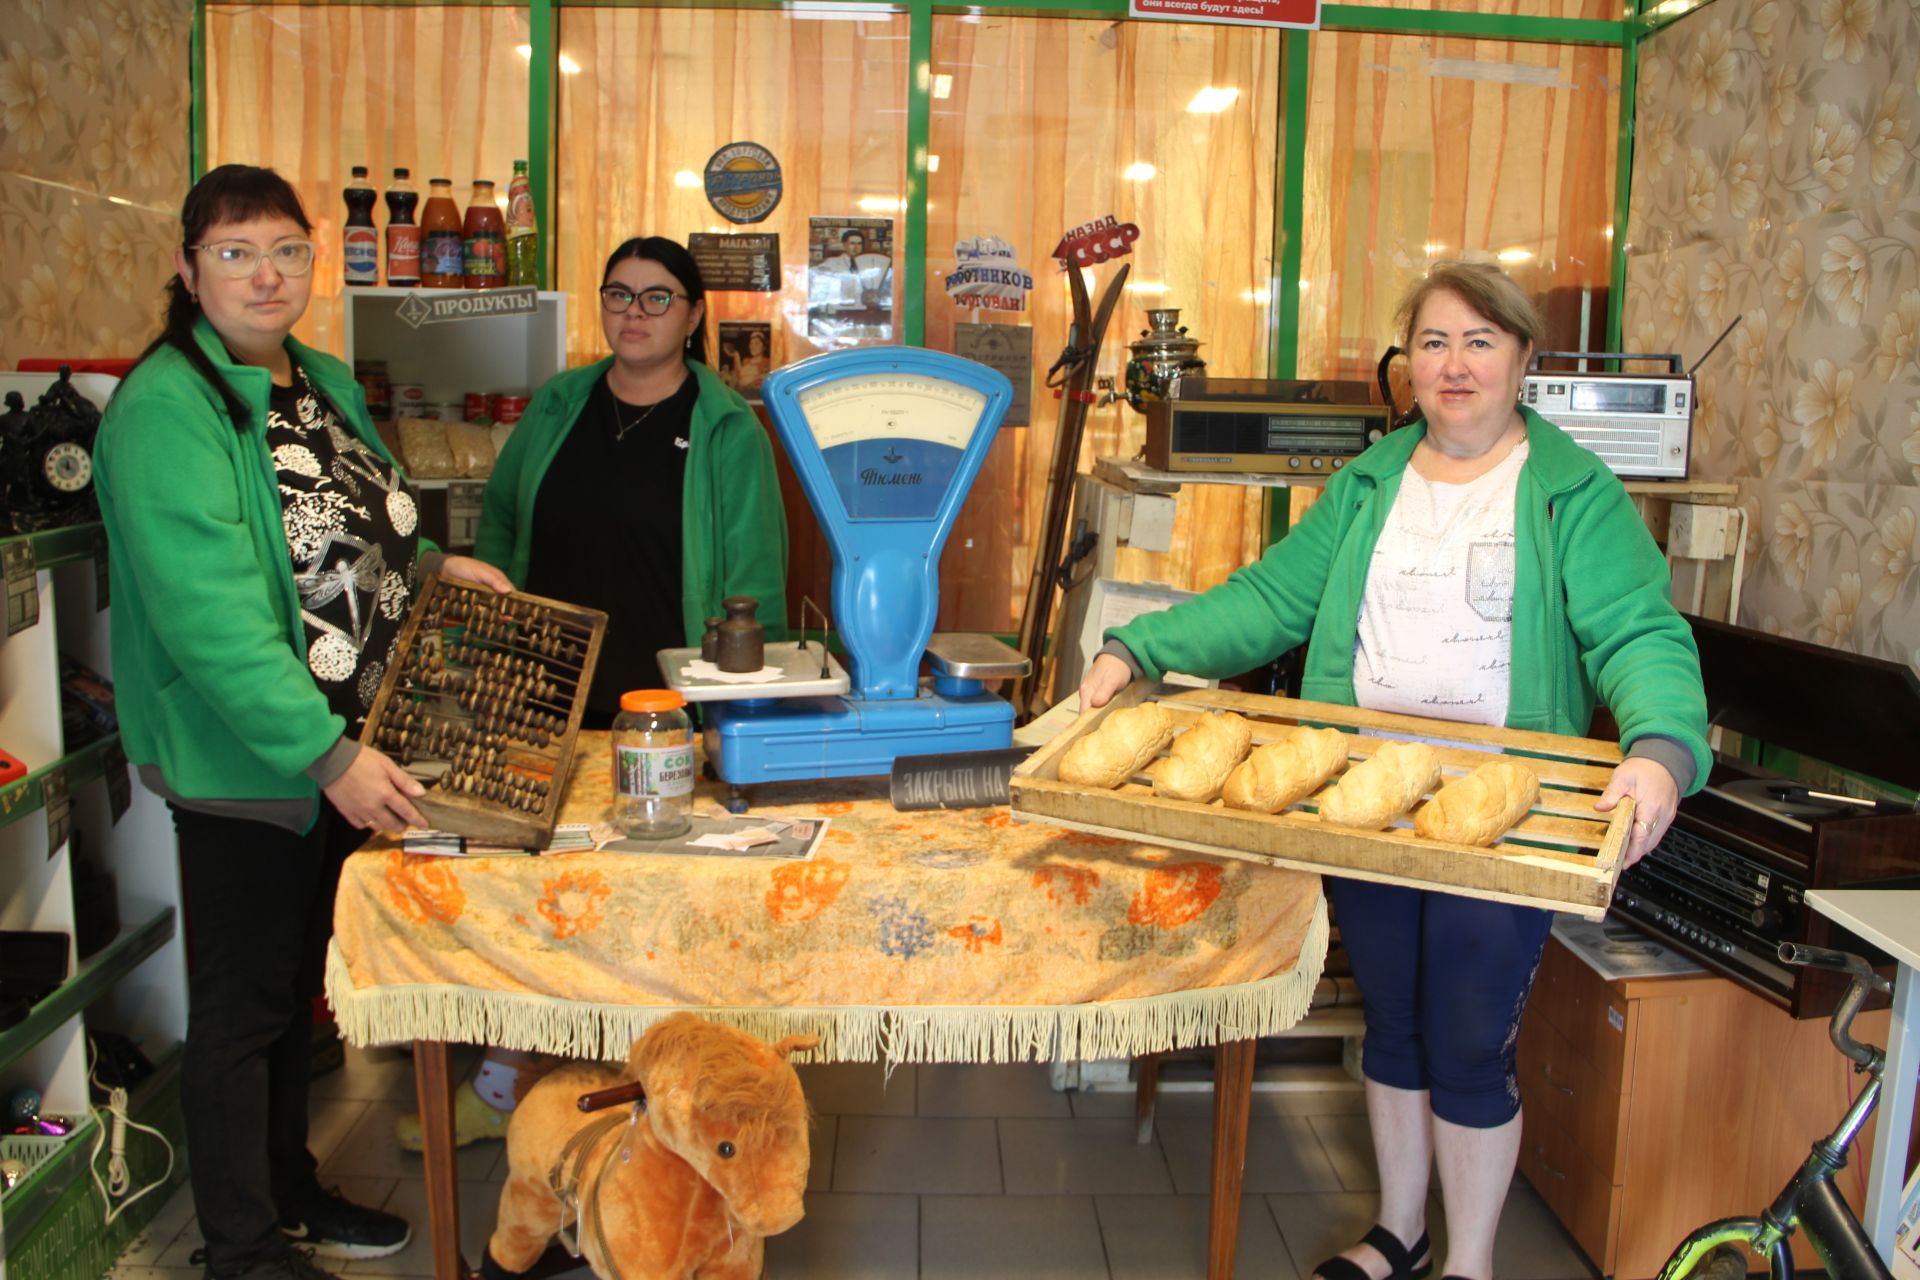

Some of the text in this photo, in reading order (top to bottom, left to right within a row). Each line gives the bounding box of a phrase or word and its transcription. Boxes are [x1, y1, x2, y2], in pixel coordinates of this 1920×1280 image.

[1164, 1, 1198, 11] всегда
[1200, 0, 1231, 14] будут
[1231, 5, 1264, 15] здесь!
[1066, 215, 1118, 242] НАЗАД
[433, 293, 533, 316] ПРОДУКТЫ
[903, 765, 1005, 804] ЗАКРЫТО НА
